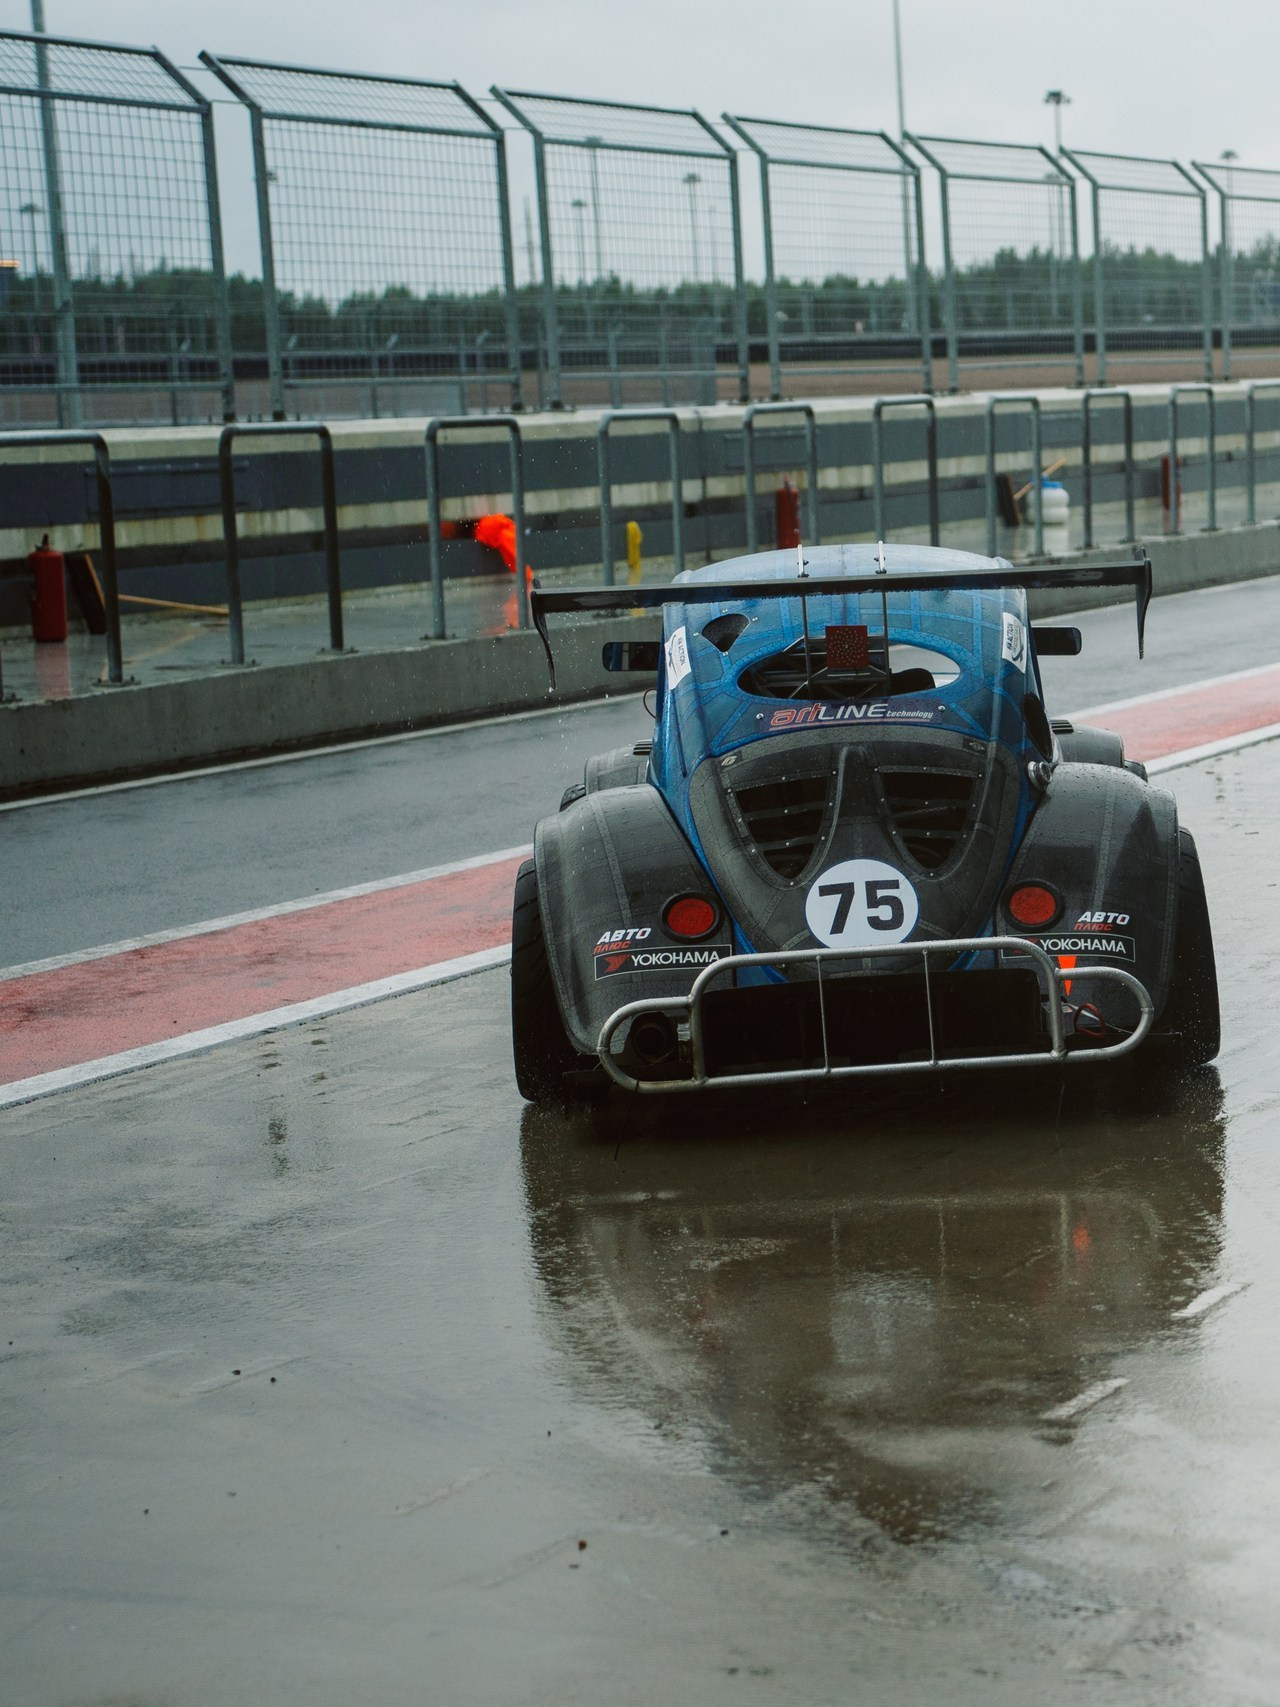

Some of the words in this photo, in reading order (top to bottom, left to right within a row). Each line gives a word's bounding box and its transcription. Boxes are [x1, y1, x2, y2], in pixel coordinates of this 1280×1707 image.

[886, 710, 934, 719] technology
[818, 879, 905, 935] 75
[1077, 911, 1130, 925] АВТО
[597, 927, 652, 945] АВТО
[1040, 938, 1127, 954] YOKOHAMA
[631, 950, 721, 967] YOKOHAMA
